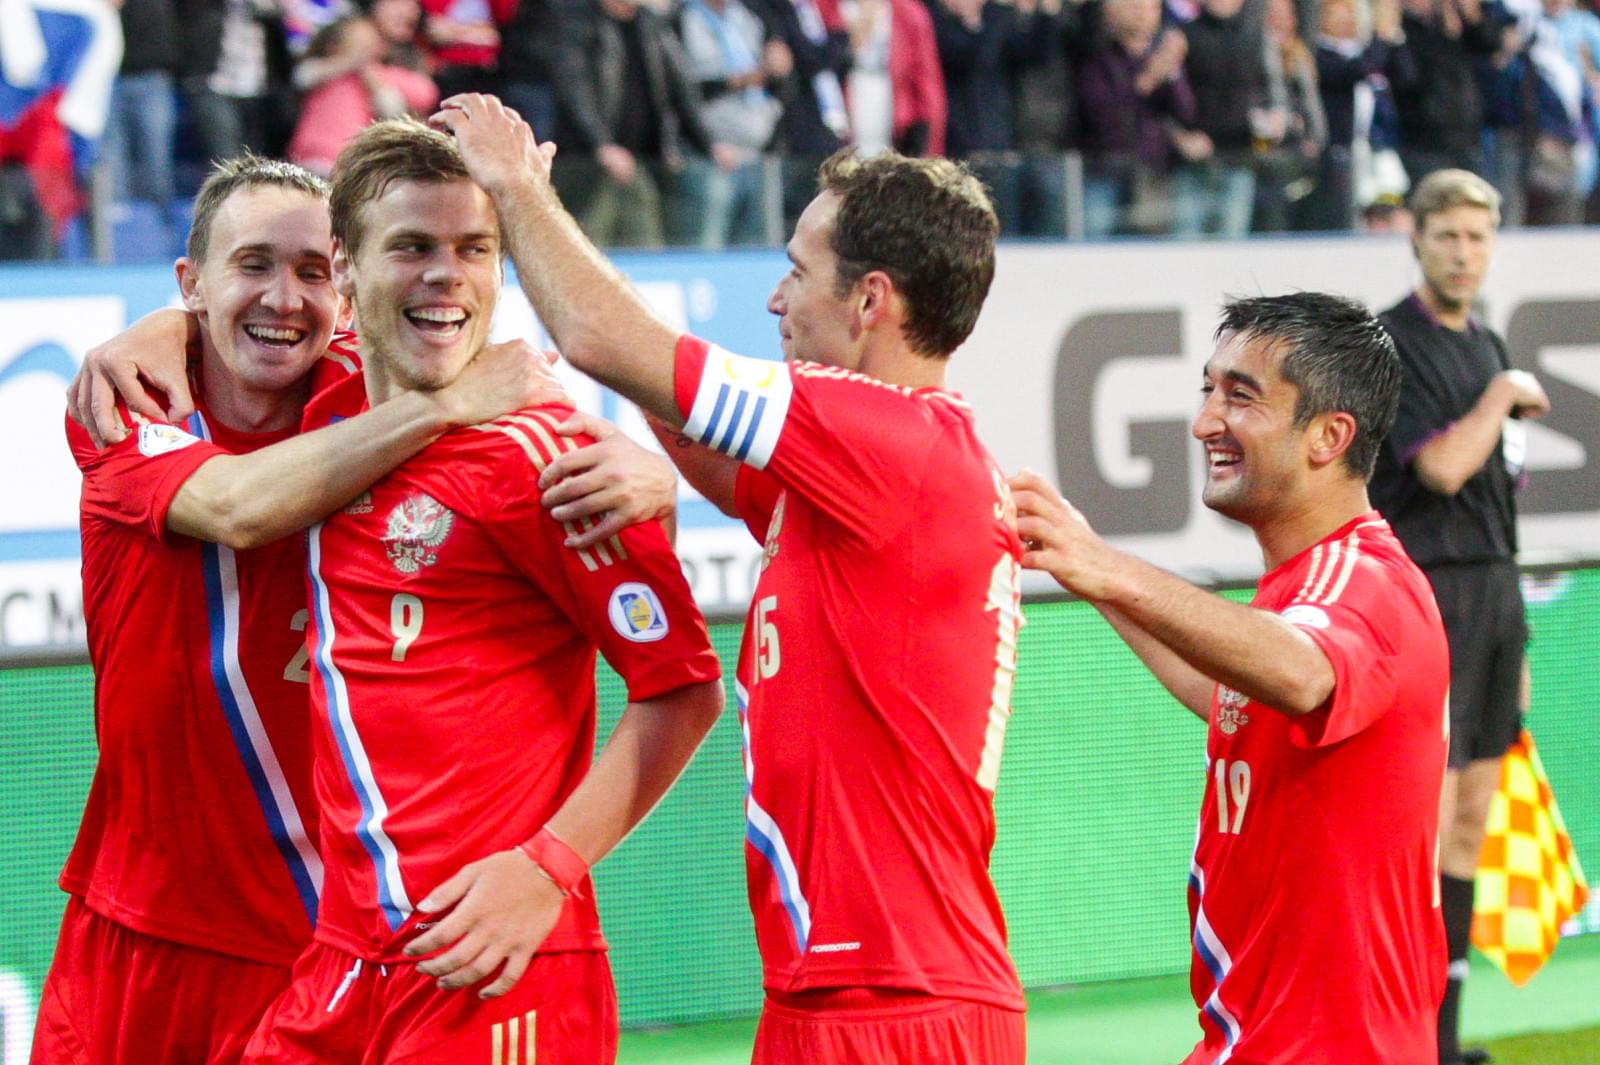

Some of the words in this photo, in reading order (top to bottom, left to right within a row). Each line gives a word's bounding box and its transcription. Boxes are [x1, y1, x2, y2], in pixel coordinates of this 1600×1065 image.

[390, 593, 424, 662] 9
[753, 594, 781, 686] 15
[1215, 758, 1251, 835] 19
